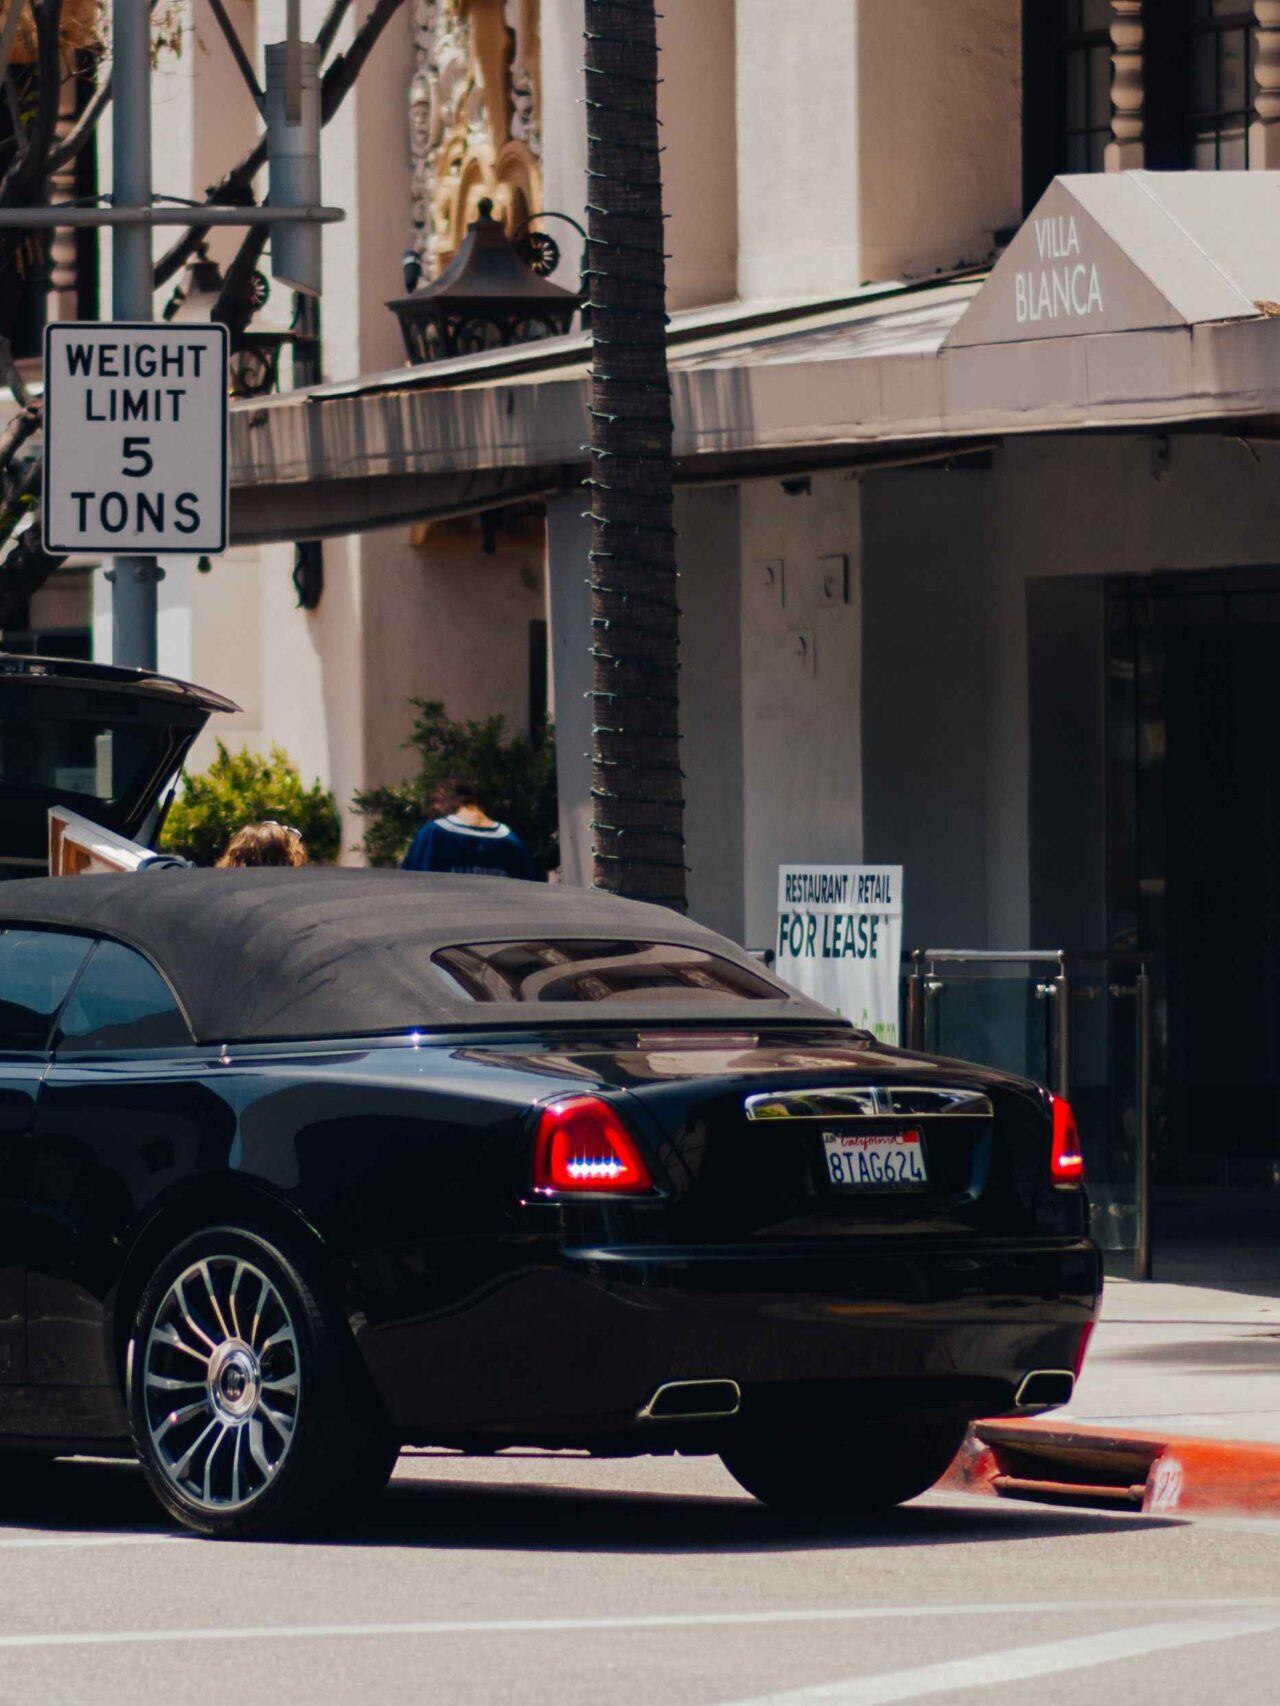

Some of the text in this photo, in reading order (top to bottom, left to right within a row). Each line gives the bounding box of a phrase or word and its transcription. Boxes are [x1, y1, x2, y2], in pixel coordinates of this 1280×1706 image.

[1034, 216, 1080, 260] VILLA
[1015, 263, 1103, 322] BLANCA
[66, 344, 207, 377] WEIGHT
[86, 389, 186, 421] LIMIT
[121, 437, 154, 478] 5
[70, 491, 201, 533] TONS
[786, 874, 848, 903] RESTAURANT
[858, 875, 891, 904] RETAIL
[779, 913, 879, 959] FOR LEASE
[829, 1150, 923, 1182] 8TAG624
